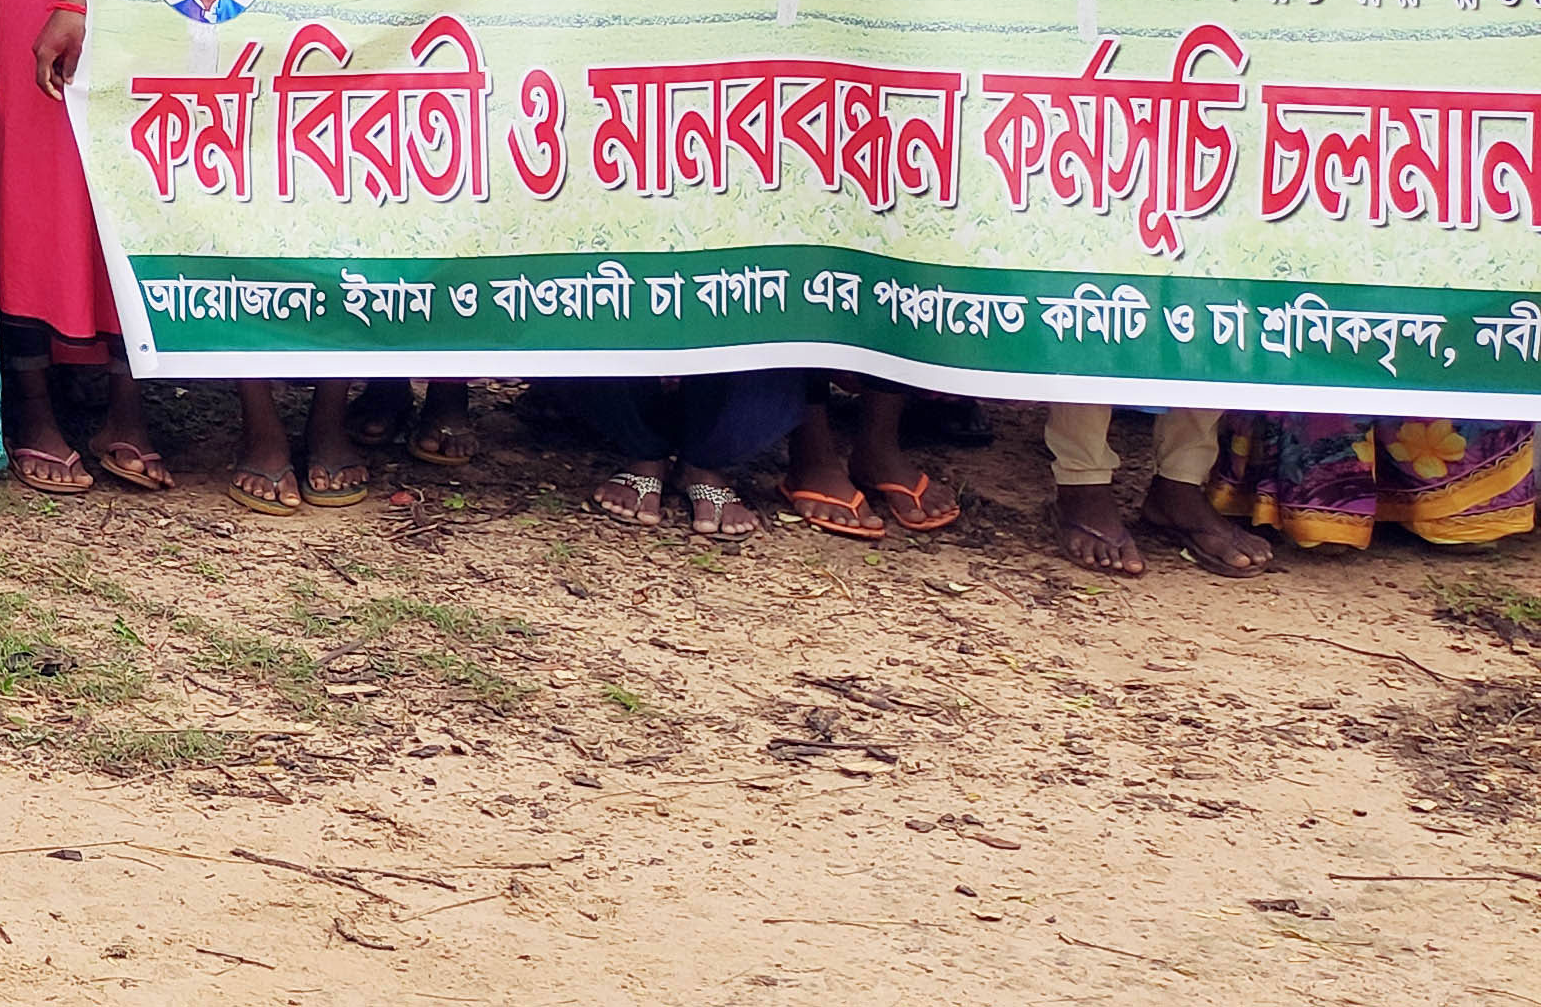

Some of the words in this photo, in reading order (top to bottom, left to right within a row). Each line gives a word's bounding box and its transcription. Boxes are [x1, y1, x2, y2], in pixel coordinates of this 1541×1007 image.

[131, 42, 257, 196] কর্ম
[272, 16, 485, 198] বিরতী
[508, 70, 560, 195] ও
[588, 60, 961, 206] মানববন্ধন
[983, 24, 1243, 252] কর্মসূচি
[340, 269, 435, 326] ইমাম
[449, 284, 477, 316] ও
[490, 261, 635, 321] বাওয়ানী
[644, 272, 685, 319] চা
[693, 266, 789, 316] বাগান
[804, 271, 861, 314] এর
[874, 279, 1028, 337] পঞ্চায়েত
[1037, 283, 1150, 343] কমিটি
[1164, 305, 1194, 342] ও
[1206, 300, 1249, 350] চা
[1258, 293, 1455, 377] শ্রমিকবৃন্দ,
